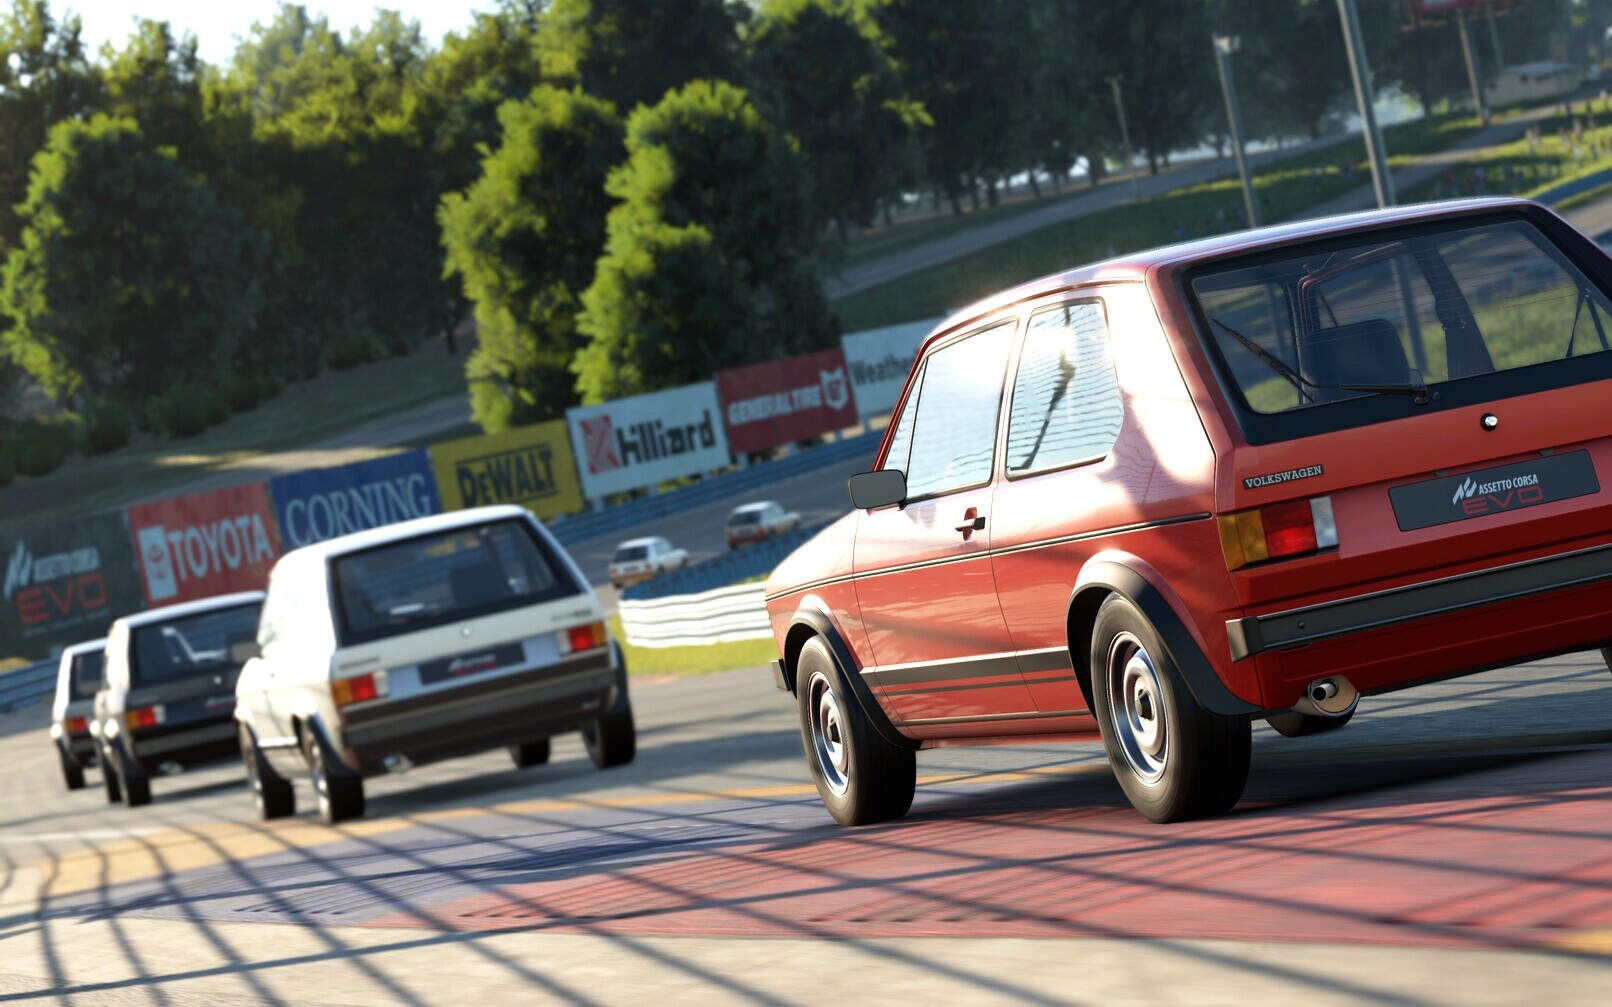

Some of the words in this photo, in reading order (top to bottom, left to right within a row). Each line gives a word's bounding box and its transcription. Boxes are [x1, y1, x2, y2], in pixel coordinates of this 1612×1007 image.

[1245, 465, 1322, 488] VOLKSWAGEN
[1479, 479, 1512, 495] ASSETTO
[1513, 473, 1539, 488] CORSA
[286, 473, 431, 547] CORNING
[1462, 485, 1544, 515] EVO
[168, 513, 273, 581] TOYOTA
[16, 571, 107, 625] EVO
